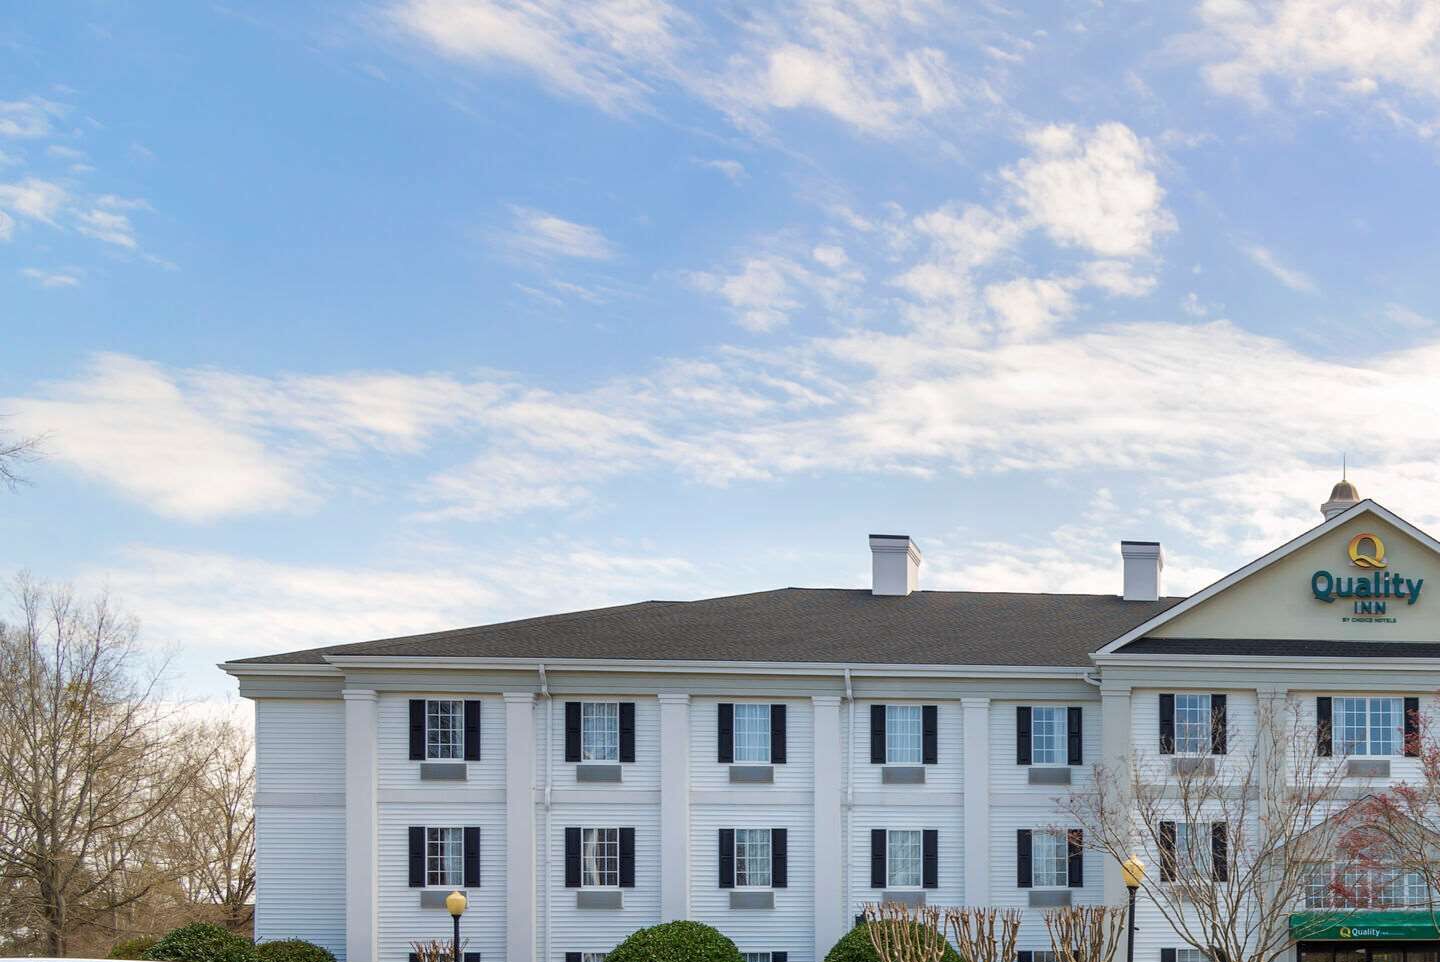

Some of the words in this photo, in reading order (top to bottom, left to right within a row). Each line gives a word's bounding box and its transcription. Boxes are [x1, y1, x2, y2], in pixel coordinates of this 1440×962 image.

[1348, 533, 1388, 568] Q
[1311, 570, 1424, 605] Quality
[1354, 601, 1387, 615] INN
[1351, 927, 1380, 937] Quality
